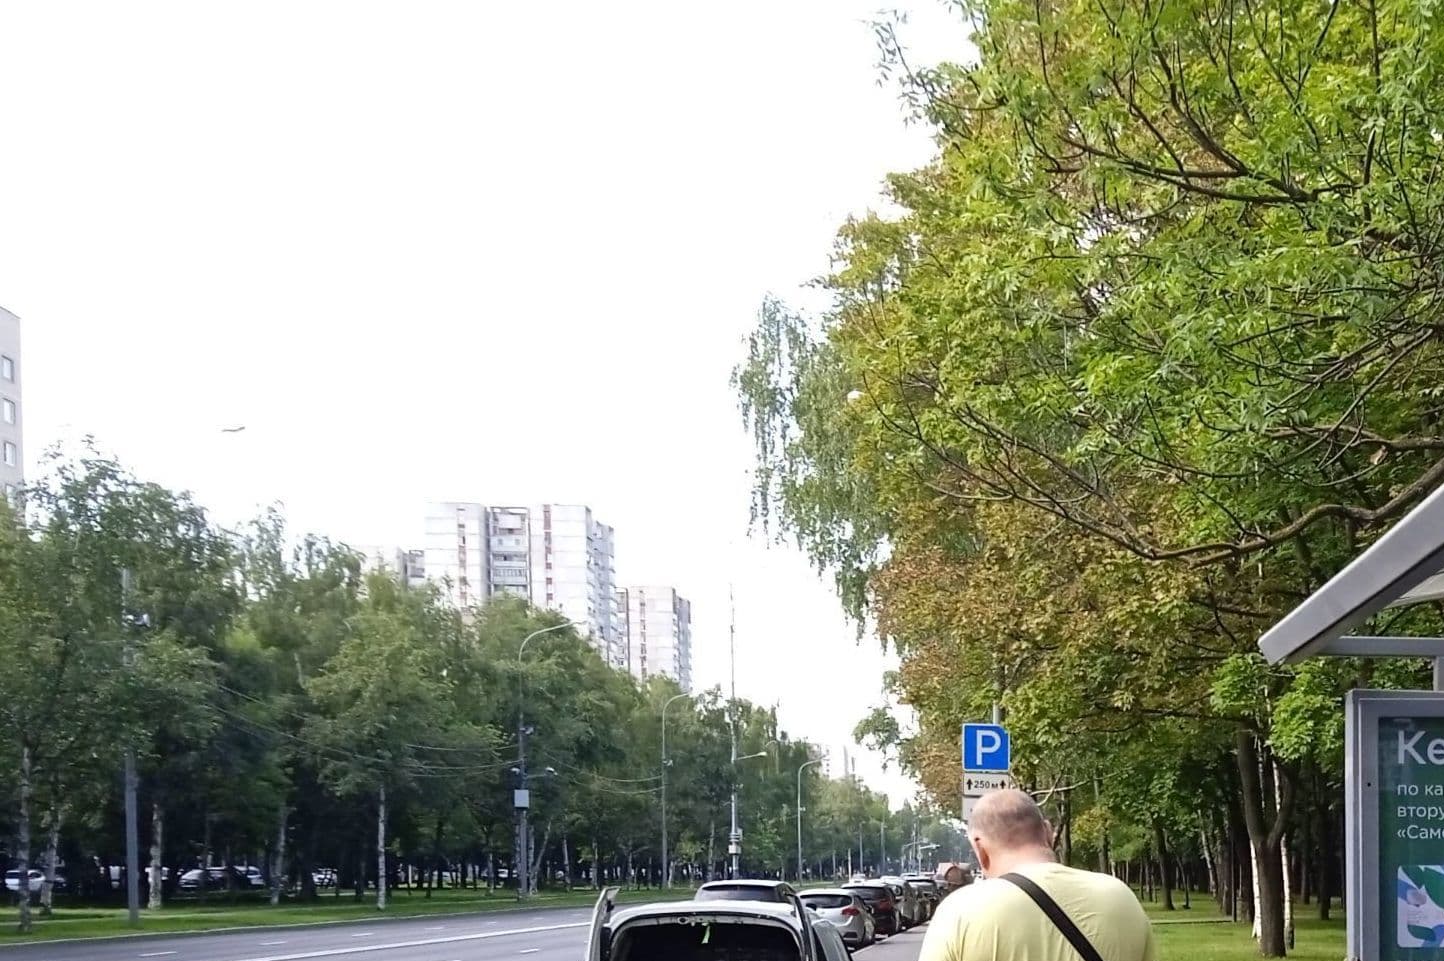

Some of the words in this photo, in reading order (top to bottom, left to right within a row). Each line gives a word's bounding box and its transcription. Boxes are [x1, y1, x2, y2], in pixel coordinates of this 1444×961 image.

[976, 730, 1001, 765] P
[974, 780, 990, 789] 250
[1397, 784, 1418, 796] по
